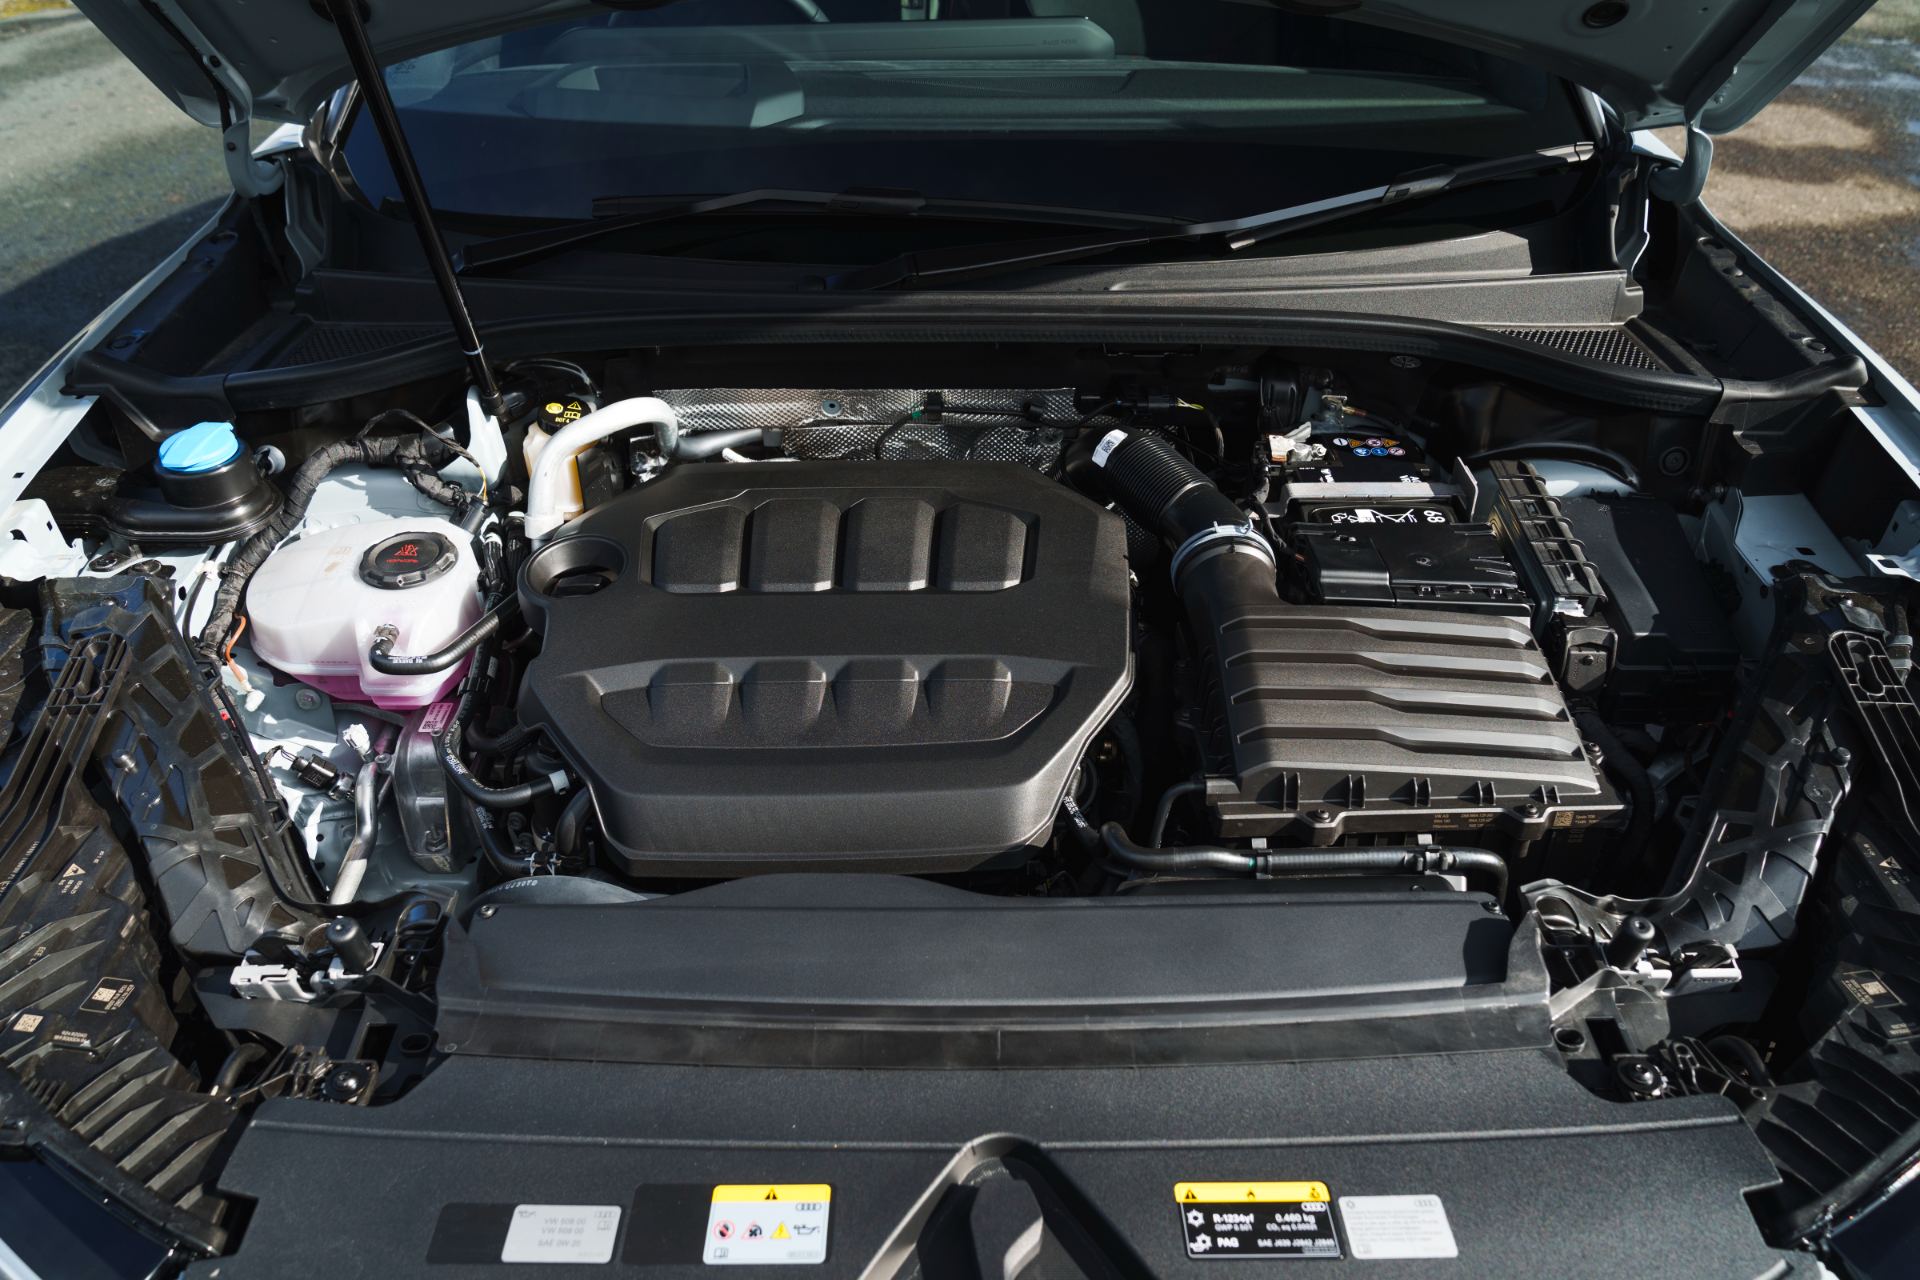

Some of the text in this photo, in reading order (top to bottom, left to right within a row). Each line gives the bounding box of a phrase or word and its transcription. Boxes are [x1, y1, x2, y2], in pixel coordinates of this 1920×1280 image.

[1424, 510, 1446, 523] 68
[1212, 1213, 1255, 1224] R-1234yf
[1303, 1213, 1316, 1225] kg
[1214, 1223, 1234, 1232] GWP
[1217, 1237, 1240, 1248] PAG
[1257, 1239, 1273, 1247] SAE
